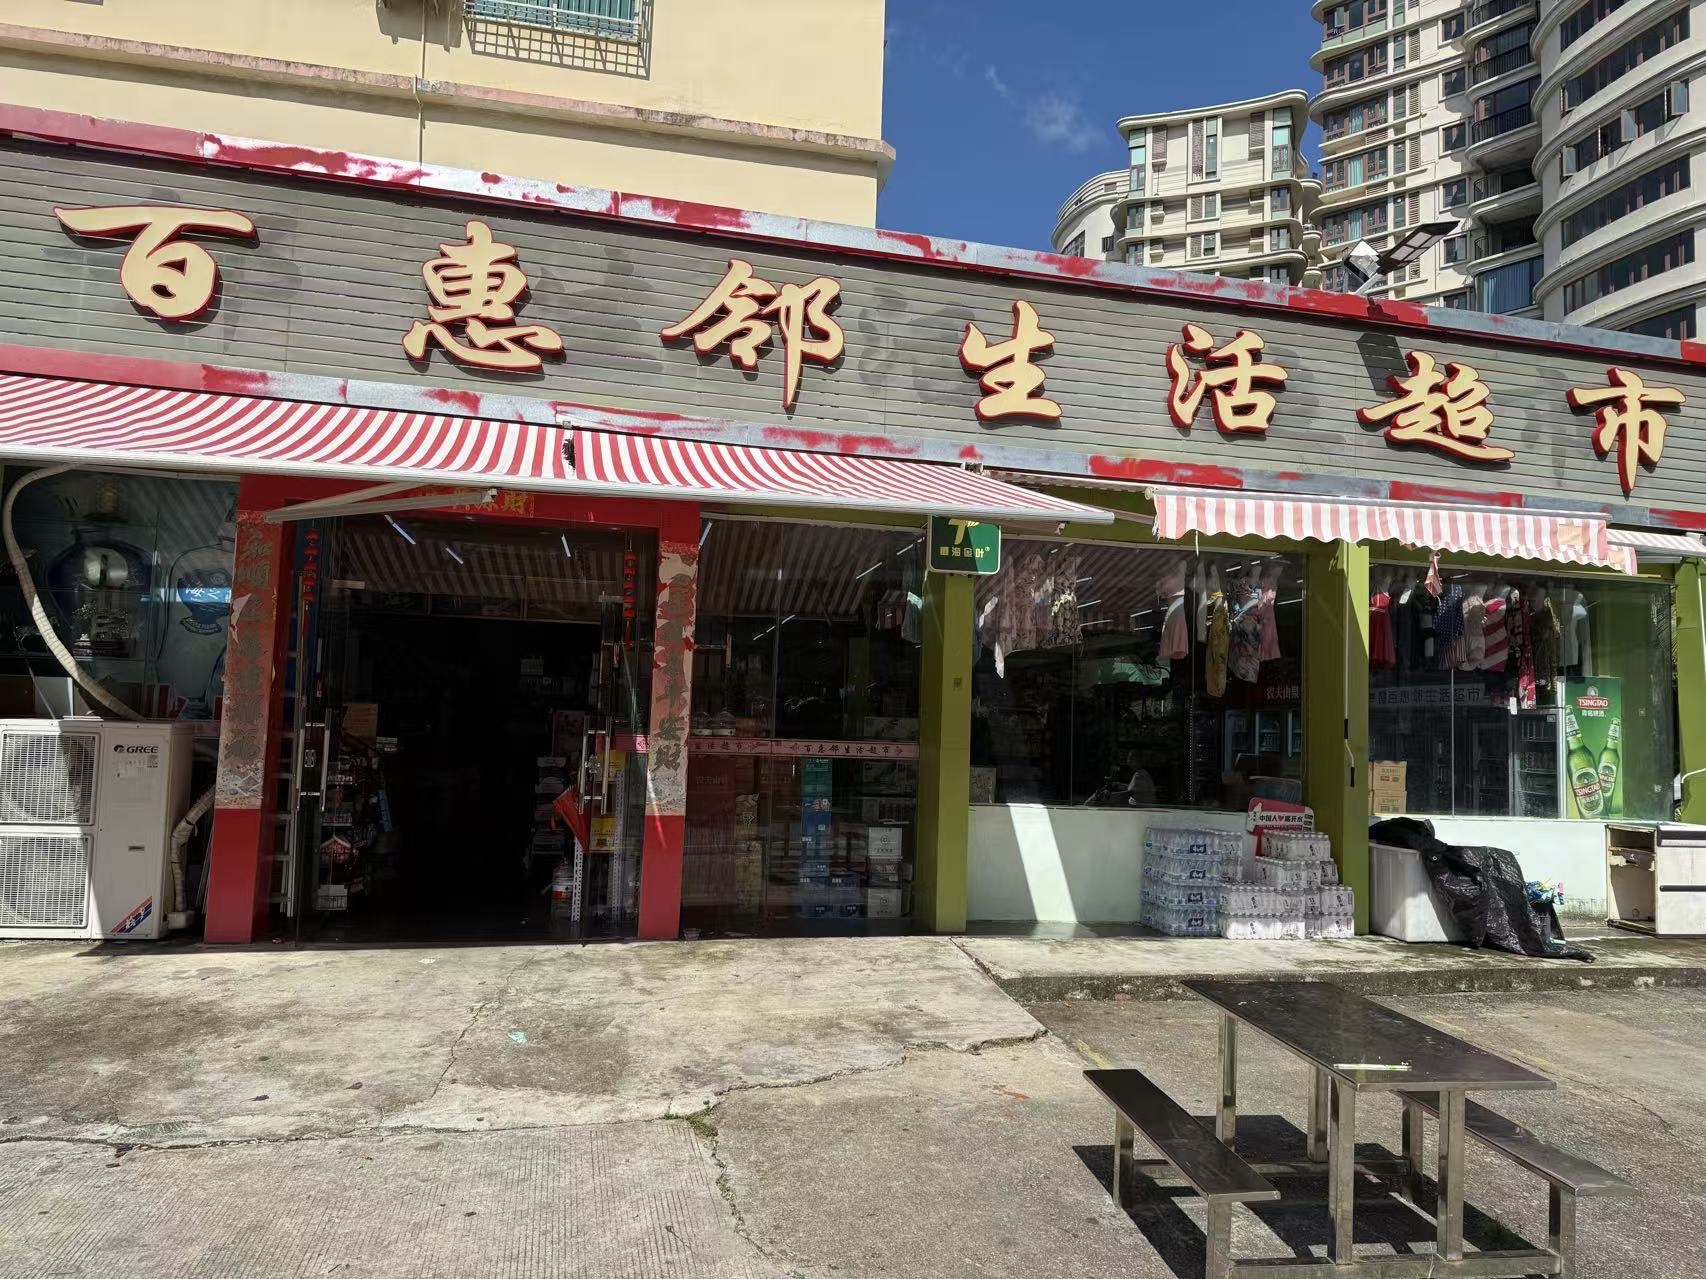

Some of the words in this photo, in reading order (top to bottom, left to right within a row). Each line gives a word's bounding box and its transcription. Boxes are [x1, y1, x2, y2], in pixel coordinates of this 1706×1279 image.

[53, 205, 1687, 496] 百惠邻生活超市
[1578, 698, 1609, 708] TSINGTAO
[126, 745, 159, 754] GREE
